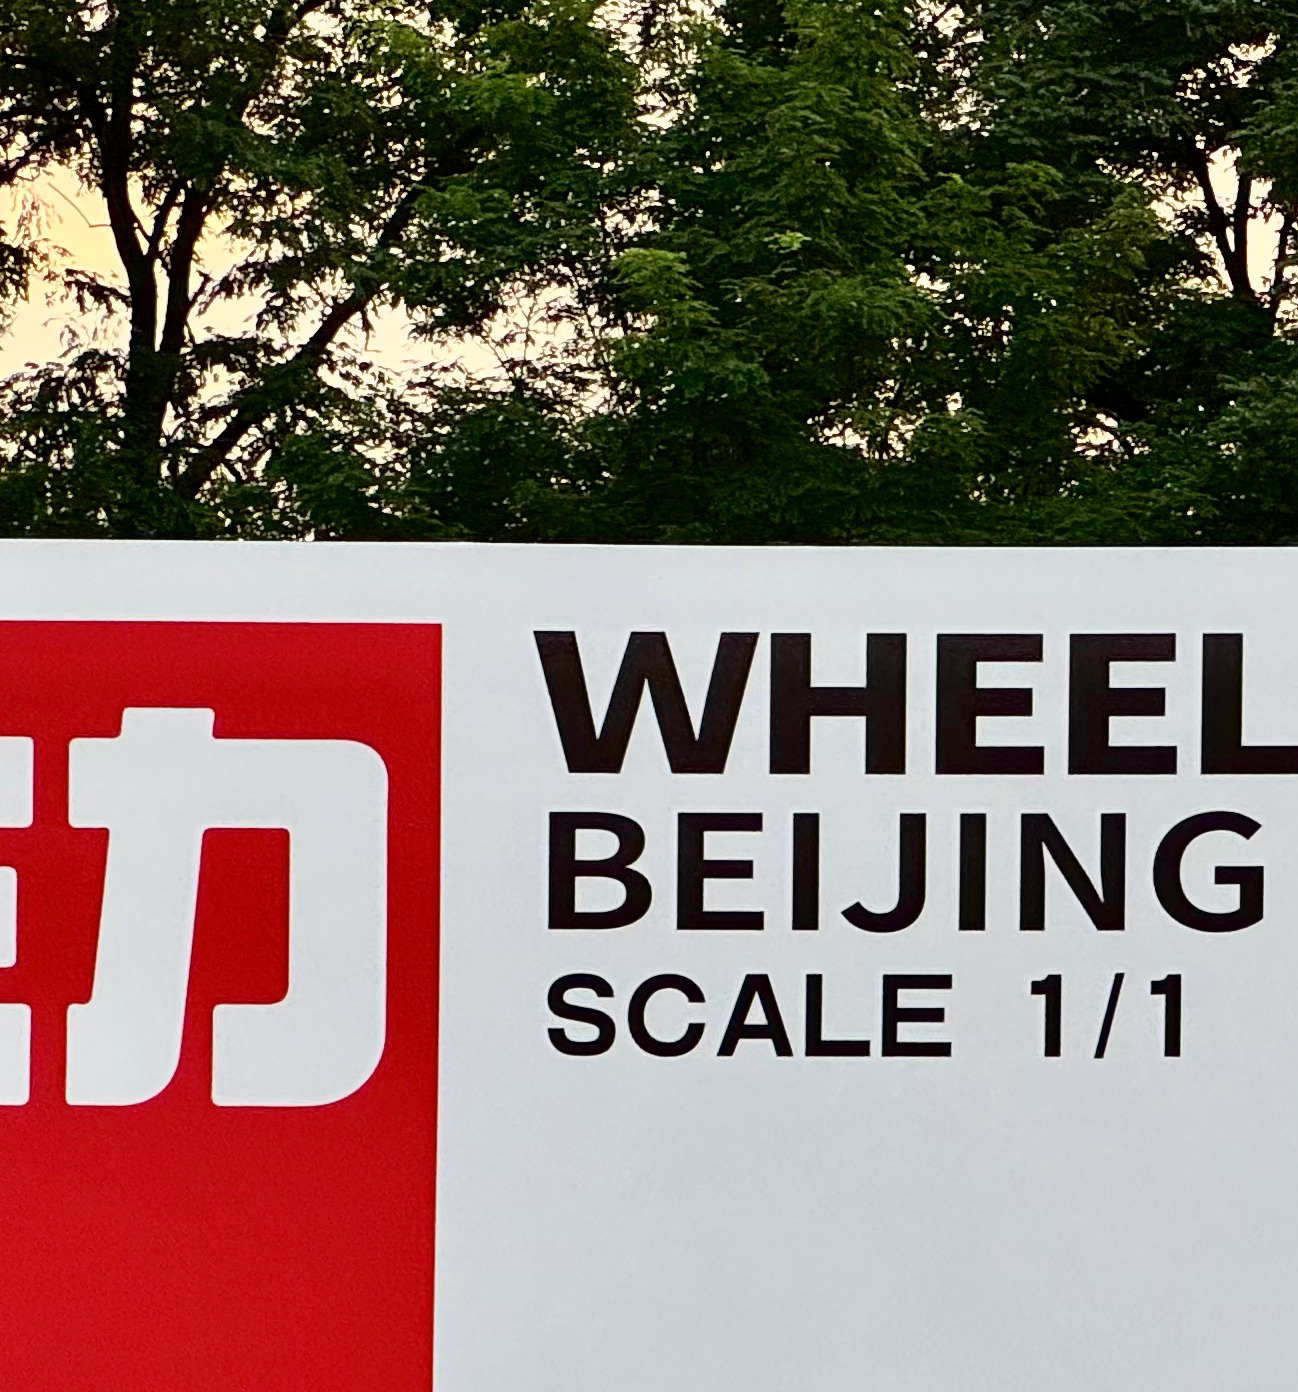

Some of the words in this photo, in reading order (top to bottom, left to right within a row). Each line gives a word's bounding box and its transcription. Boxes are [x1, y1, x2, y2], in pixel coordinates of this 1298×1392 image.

[548, 811, 1264, 933] BEIJING
[548, 973, 952, 1058] SCALE
[1031, 973, 1181, 1058] 1/1
